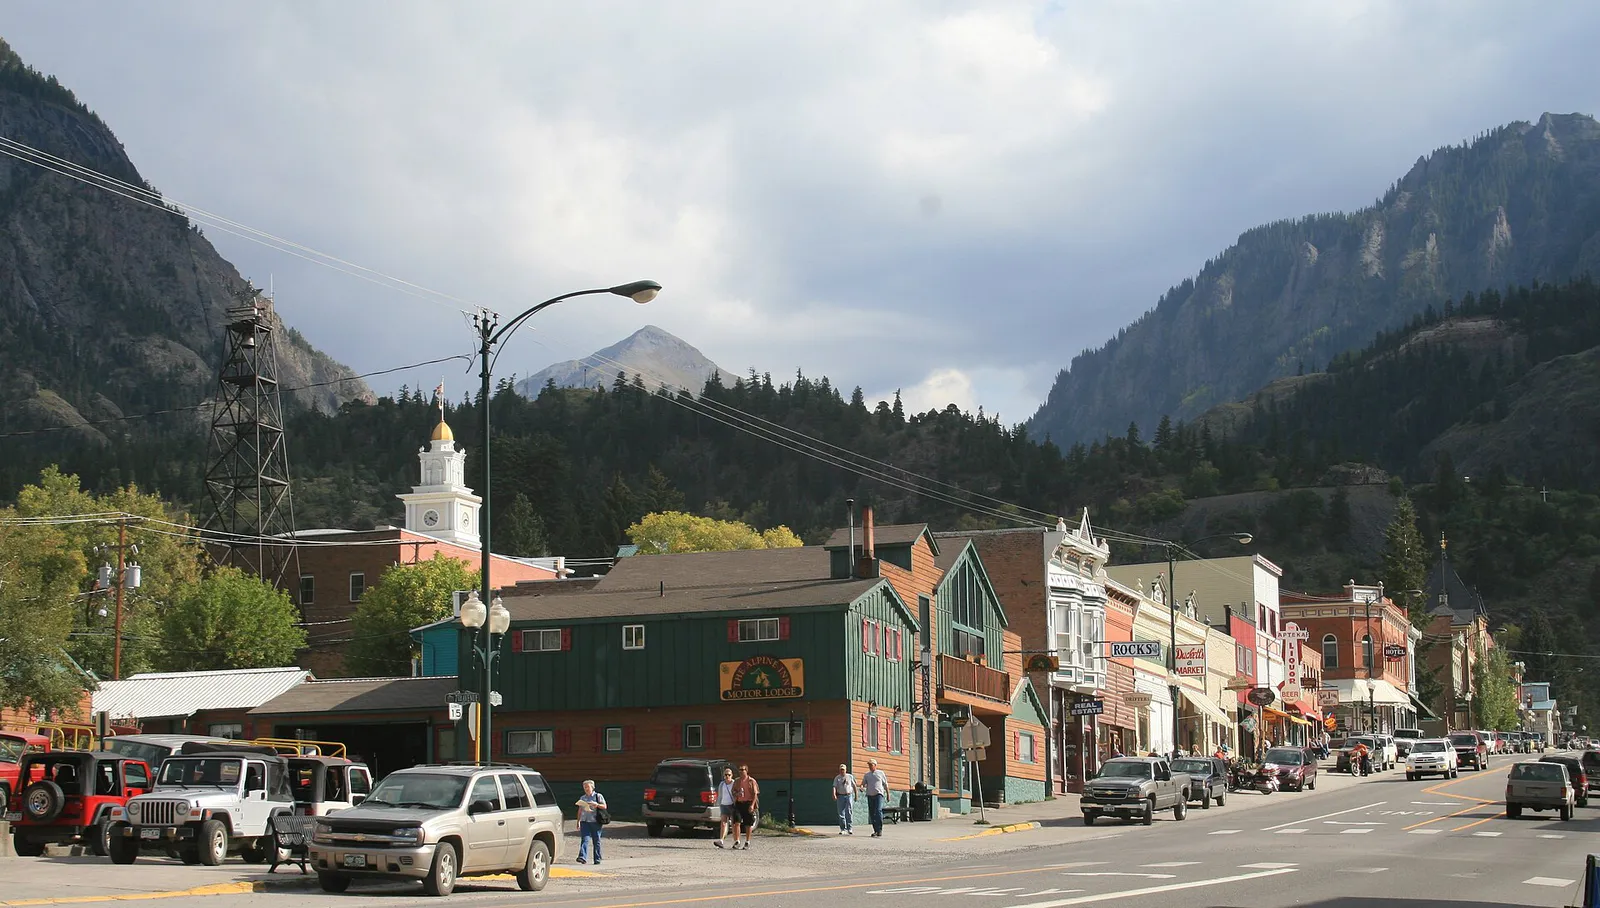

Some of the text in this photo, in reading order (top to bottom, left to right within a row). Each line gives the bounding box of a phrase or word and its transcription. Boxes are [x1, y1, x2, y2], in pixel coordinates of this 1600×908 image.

[1113, 643, 1152, 655] ROCKS
[733, 656, 790, 688] THE ALPINE INN
[1176, 666, 1204, 674] MARKET
[727, 687, 797, 699] MOTOR LODGE
[451, 709, 462, 718] 15
[1071, 707, 1103, 715] ESTATE
